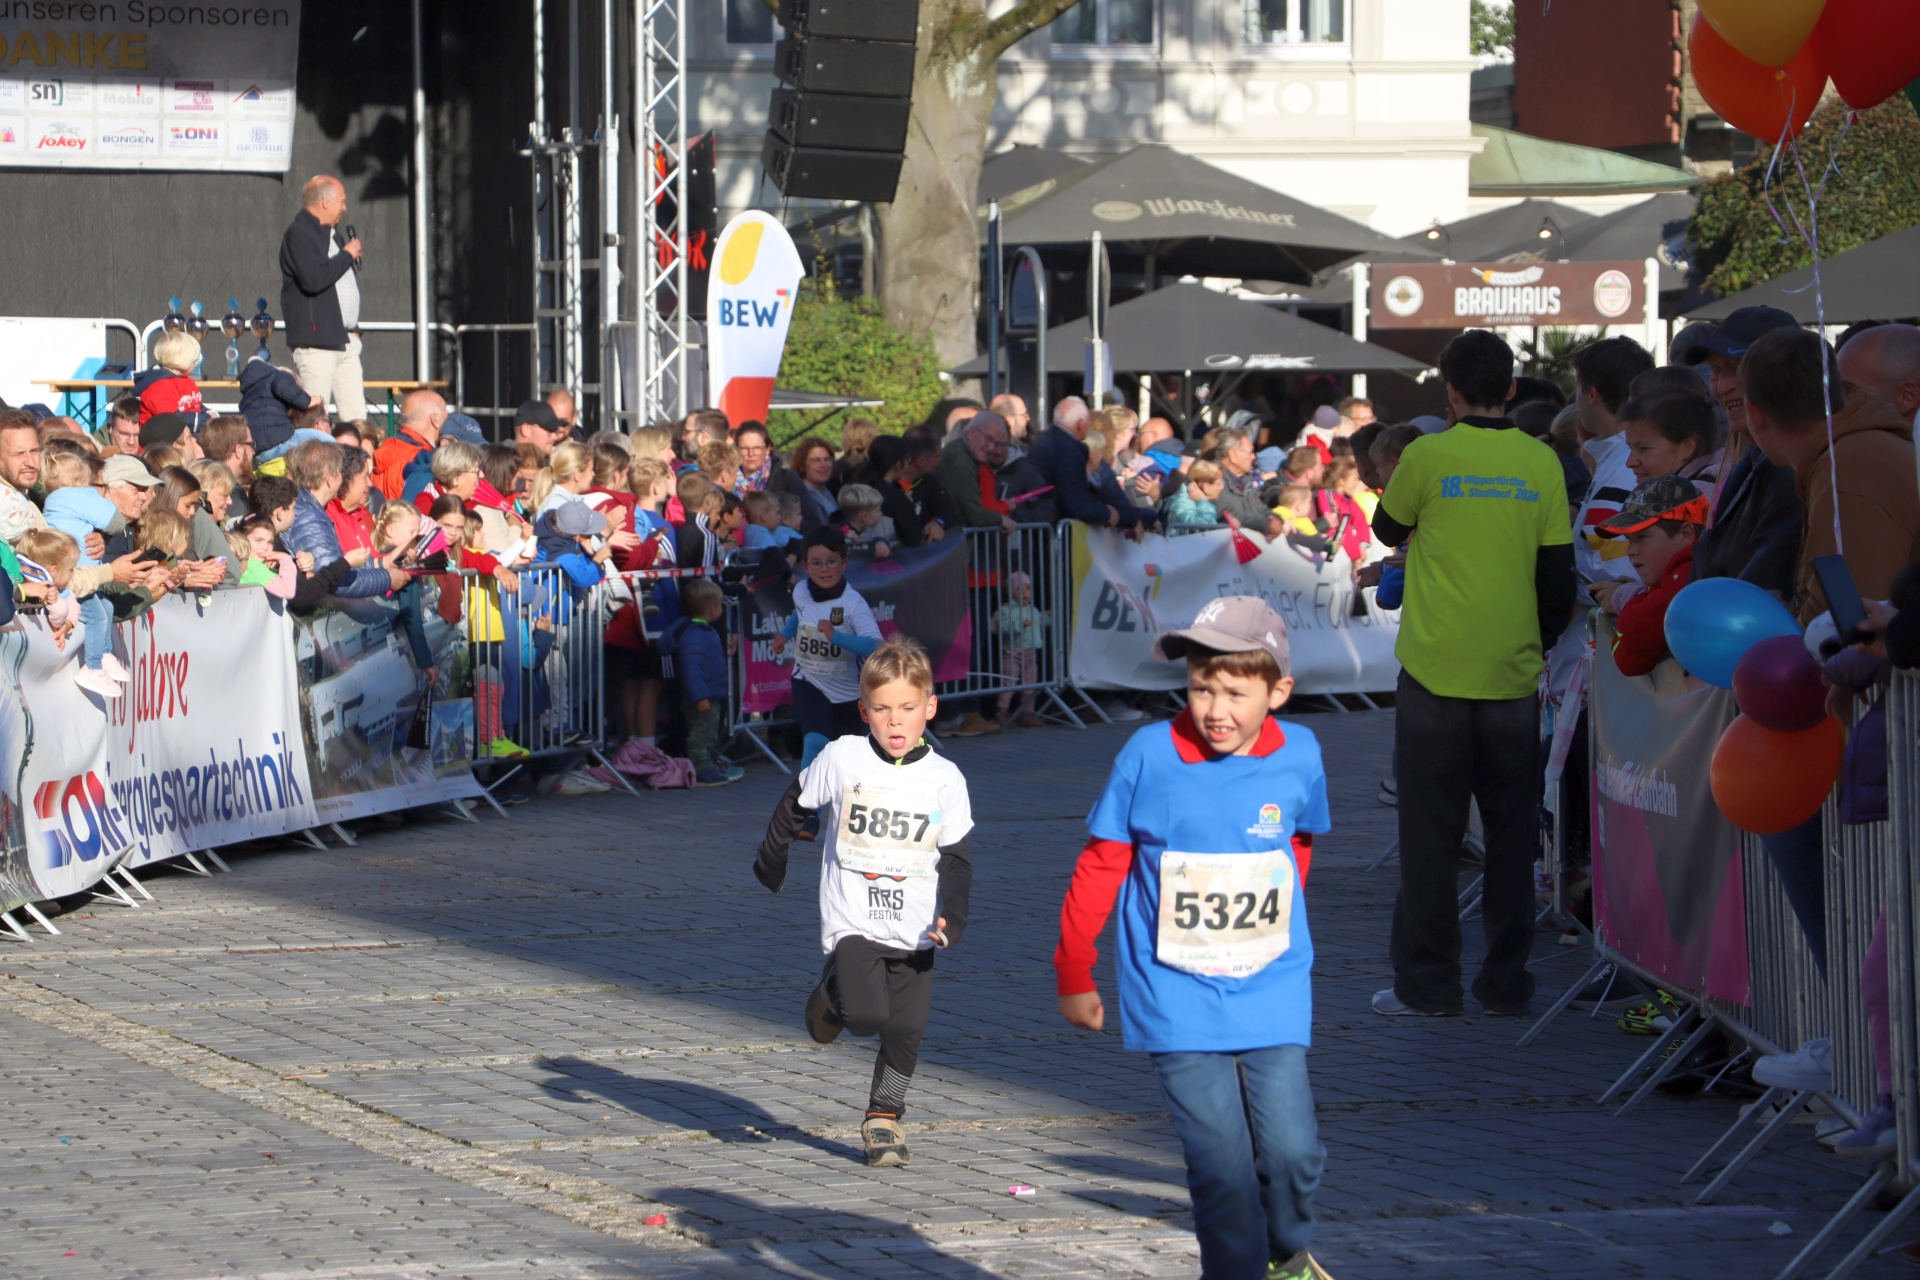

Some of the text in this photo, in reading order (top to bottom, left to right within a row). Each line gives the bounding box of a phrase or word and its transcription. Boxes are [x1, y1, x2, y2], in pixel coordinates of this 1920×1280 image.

[127, 0, 289, 28] Sponsoren
[0, 28, 148, 69] ANKE
[35, 134, 87, 150] jokey
[102, 135, 154, 143] BONGEN
[185, 127, 218, 139] ONI
[1144, 197, 1296, 229] Warsteiner
[718, 298, 779, 327] BEW
[1454, 286, 1561, 316] BRAUHAUS
[1441, 475, 1465, 498] 18.
[1468, 488, 1540, 502] Stadtlauf 2024
[799, 636, 842, 658] 5850
[847, 803, 931, 843] 5857
[868, 885, 904, 911] RRS
[1174, 888, 1280, 930] 5324
[868, 909, 904, 922] FESTIVAL
